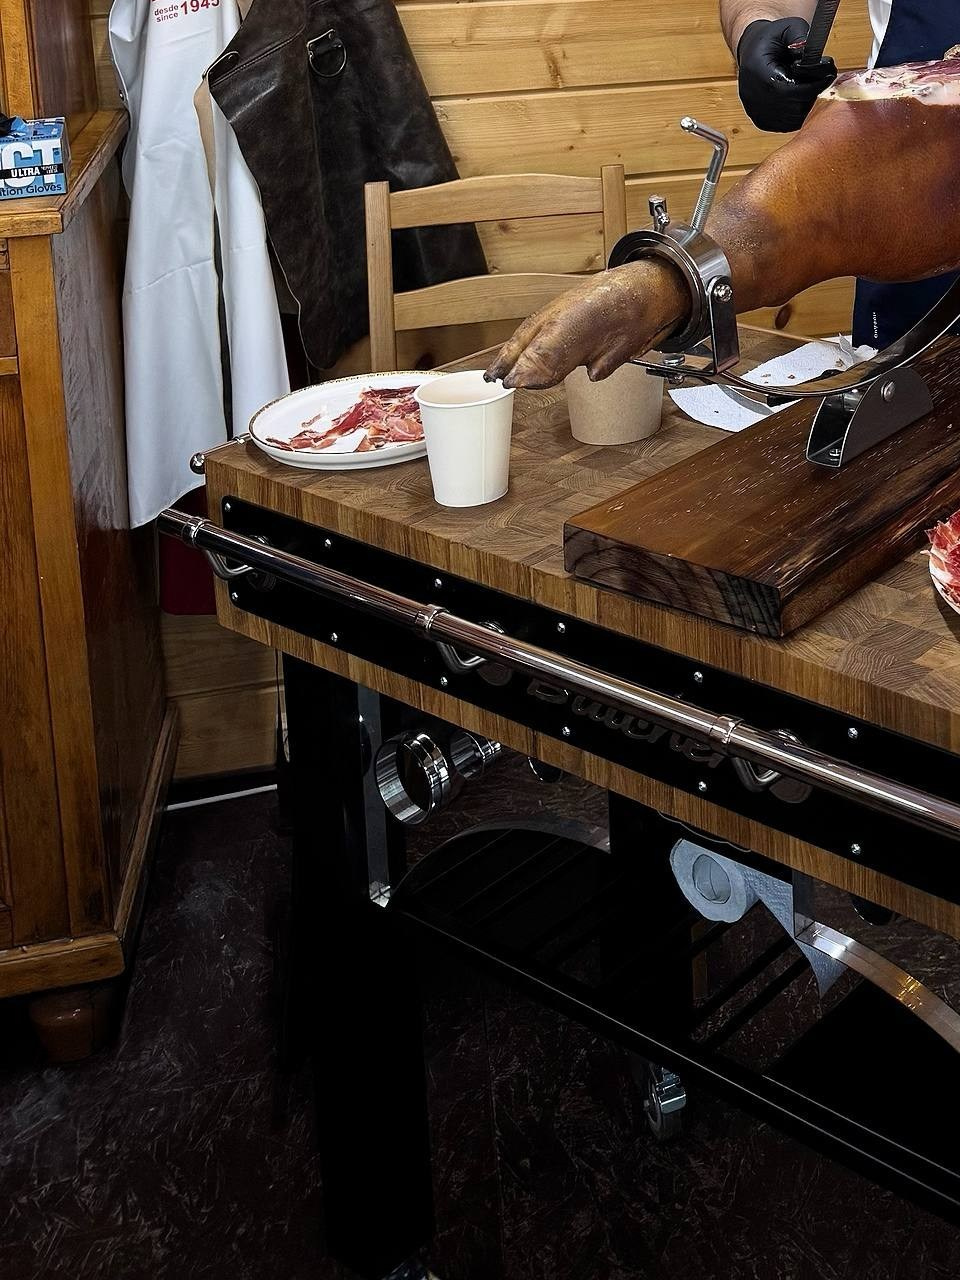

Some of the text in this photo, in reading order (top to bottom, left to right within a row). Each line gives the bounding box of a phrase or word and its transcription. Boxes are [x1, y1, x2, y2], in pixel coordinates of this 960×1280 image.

[154, 5, 179, 16] desde
[156, 12, 179, 23] since
[0, 138, 61, 188] CT
[11, 166, 40, 178] ULTRA
[26, 184, 62, 194] Gloves
